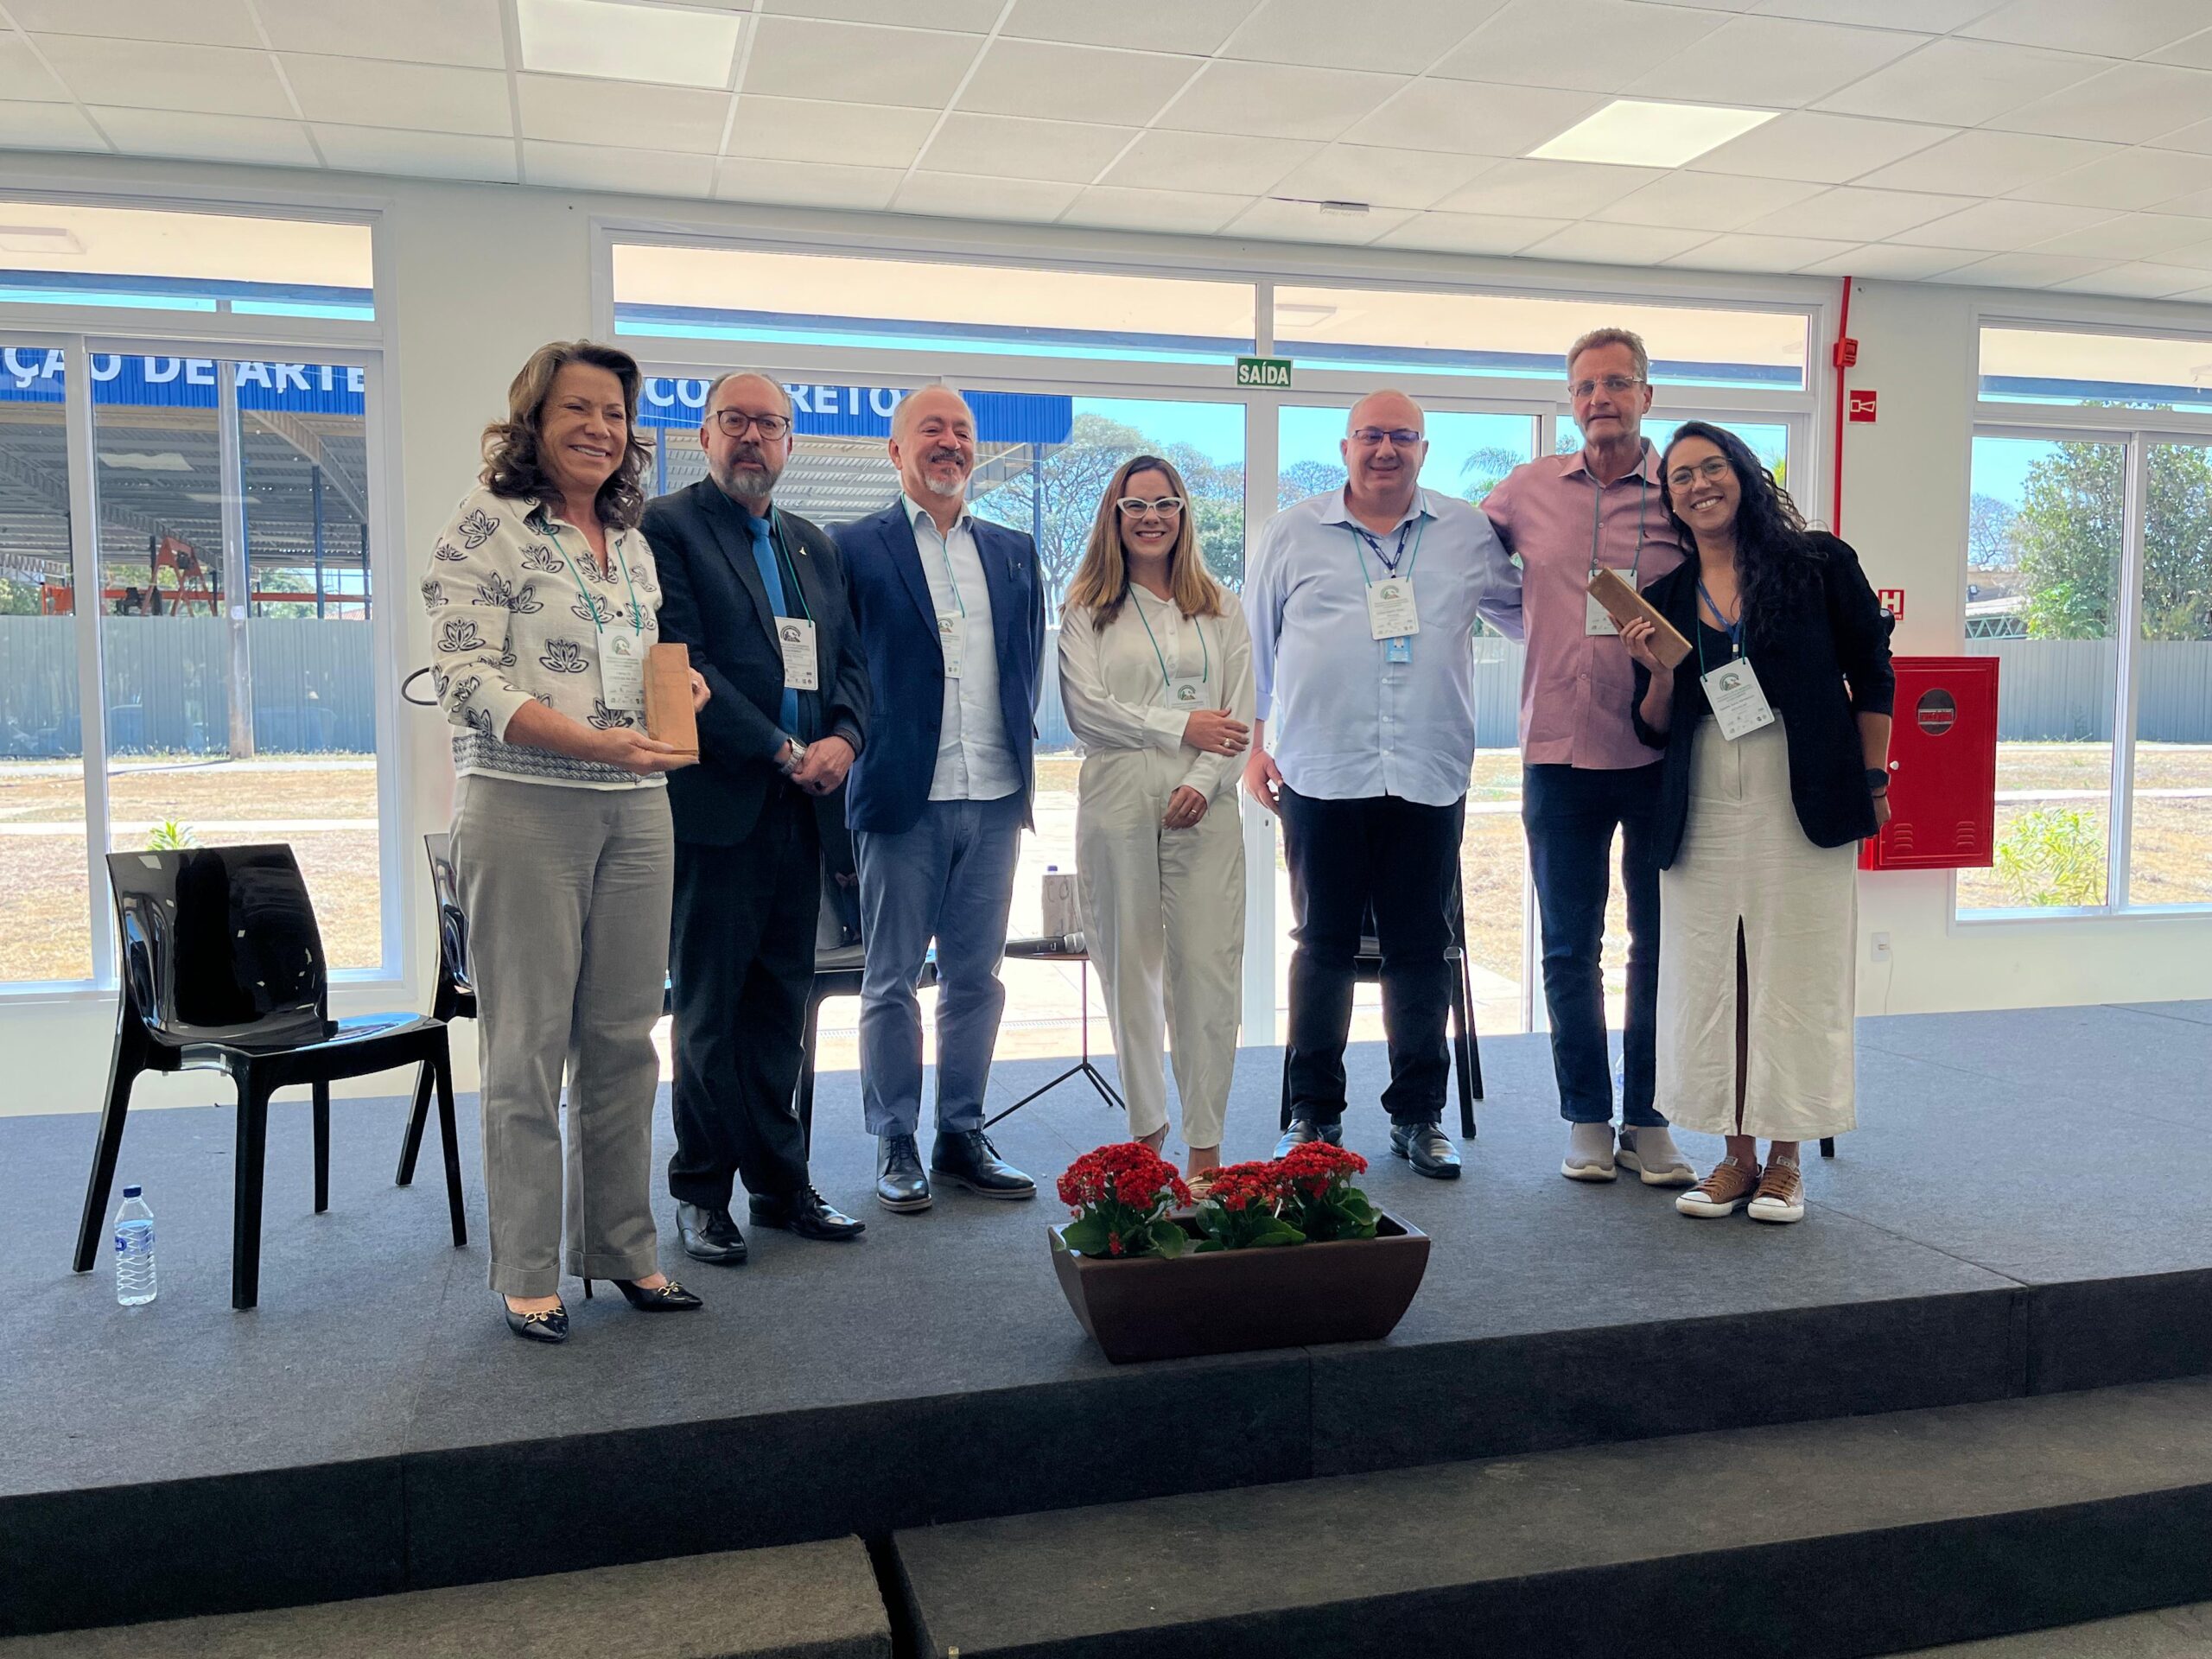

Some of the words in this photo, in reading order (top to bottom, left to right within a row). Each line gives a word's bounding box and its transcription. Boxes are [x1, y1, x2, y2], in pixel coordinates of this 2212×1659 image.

[144, 355, 215, 385] DE
[1238, 361, 1289, 385] SAÍDA
[1881, 591, 1901, 613] H
